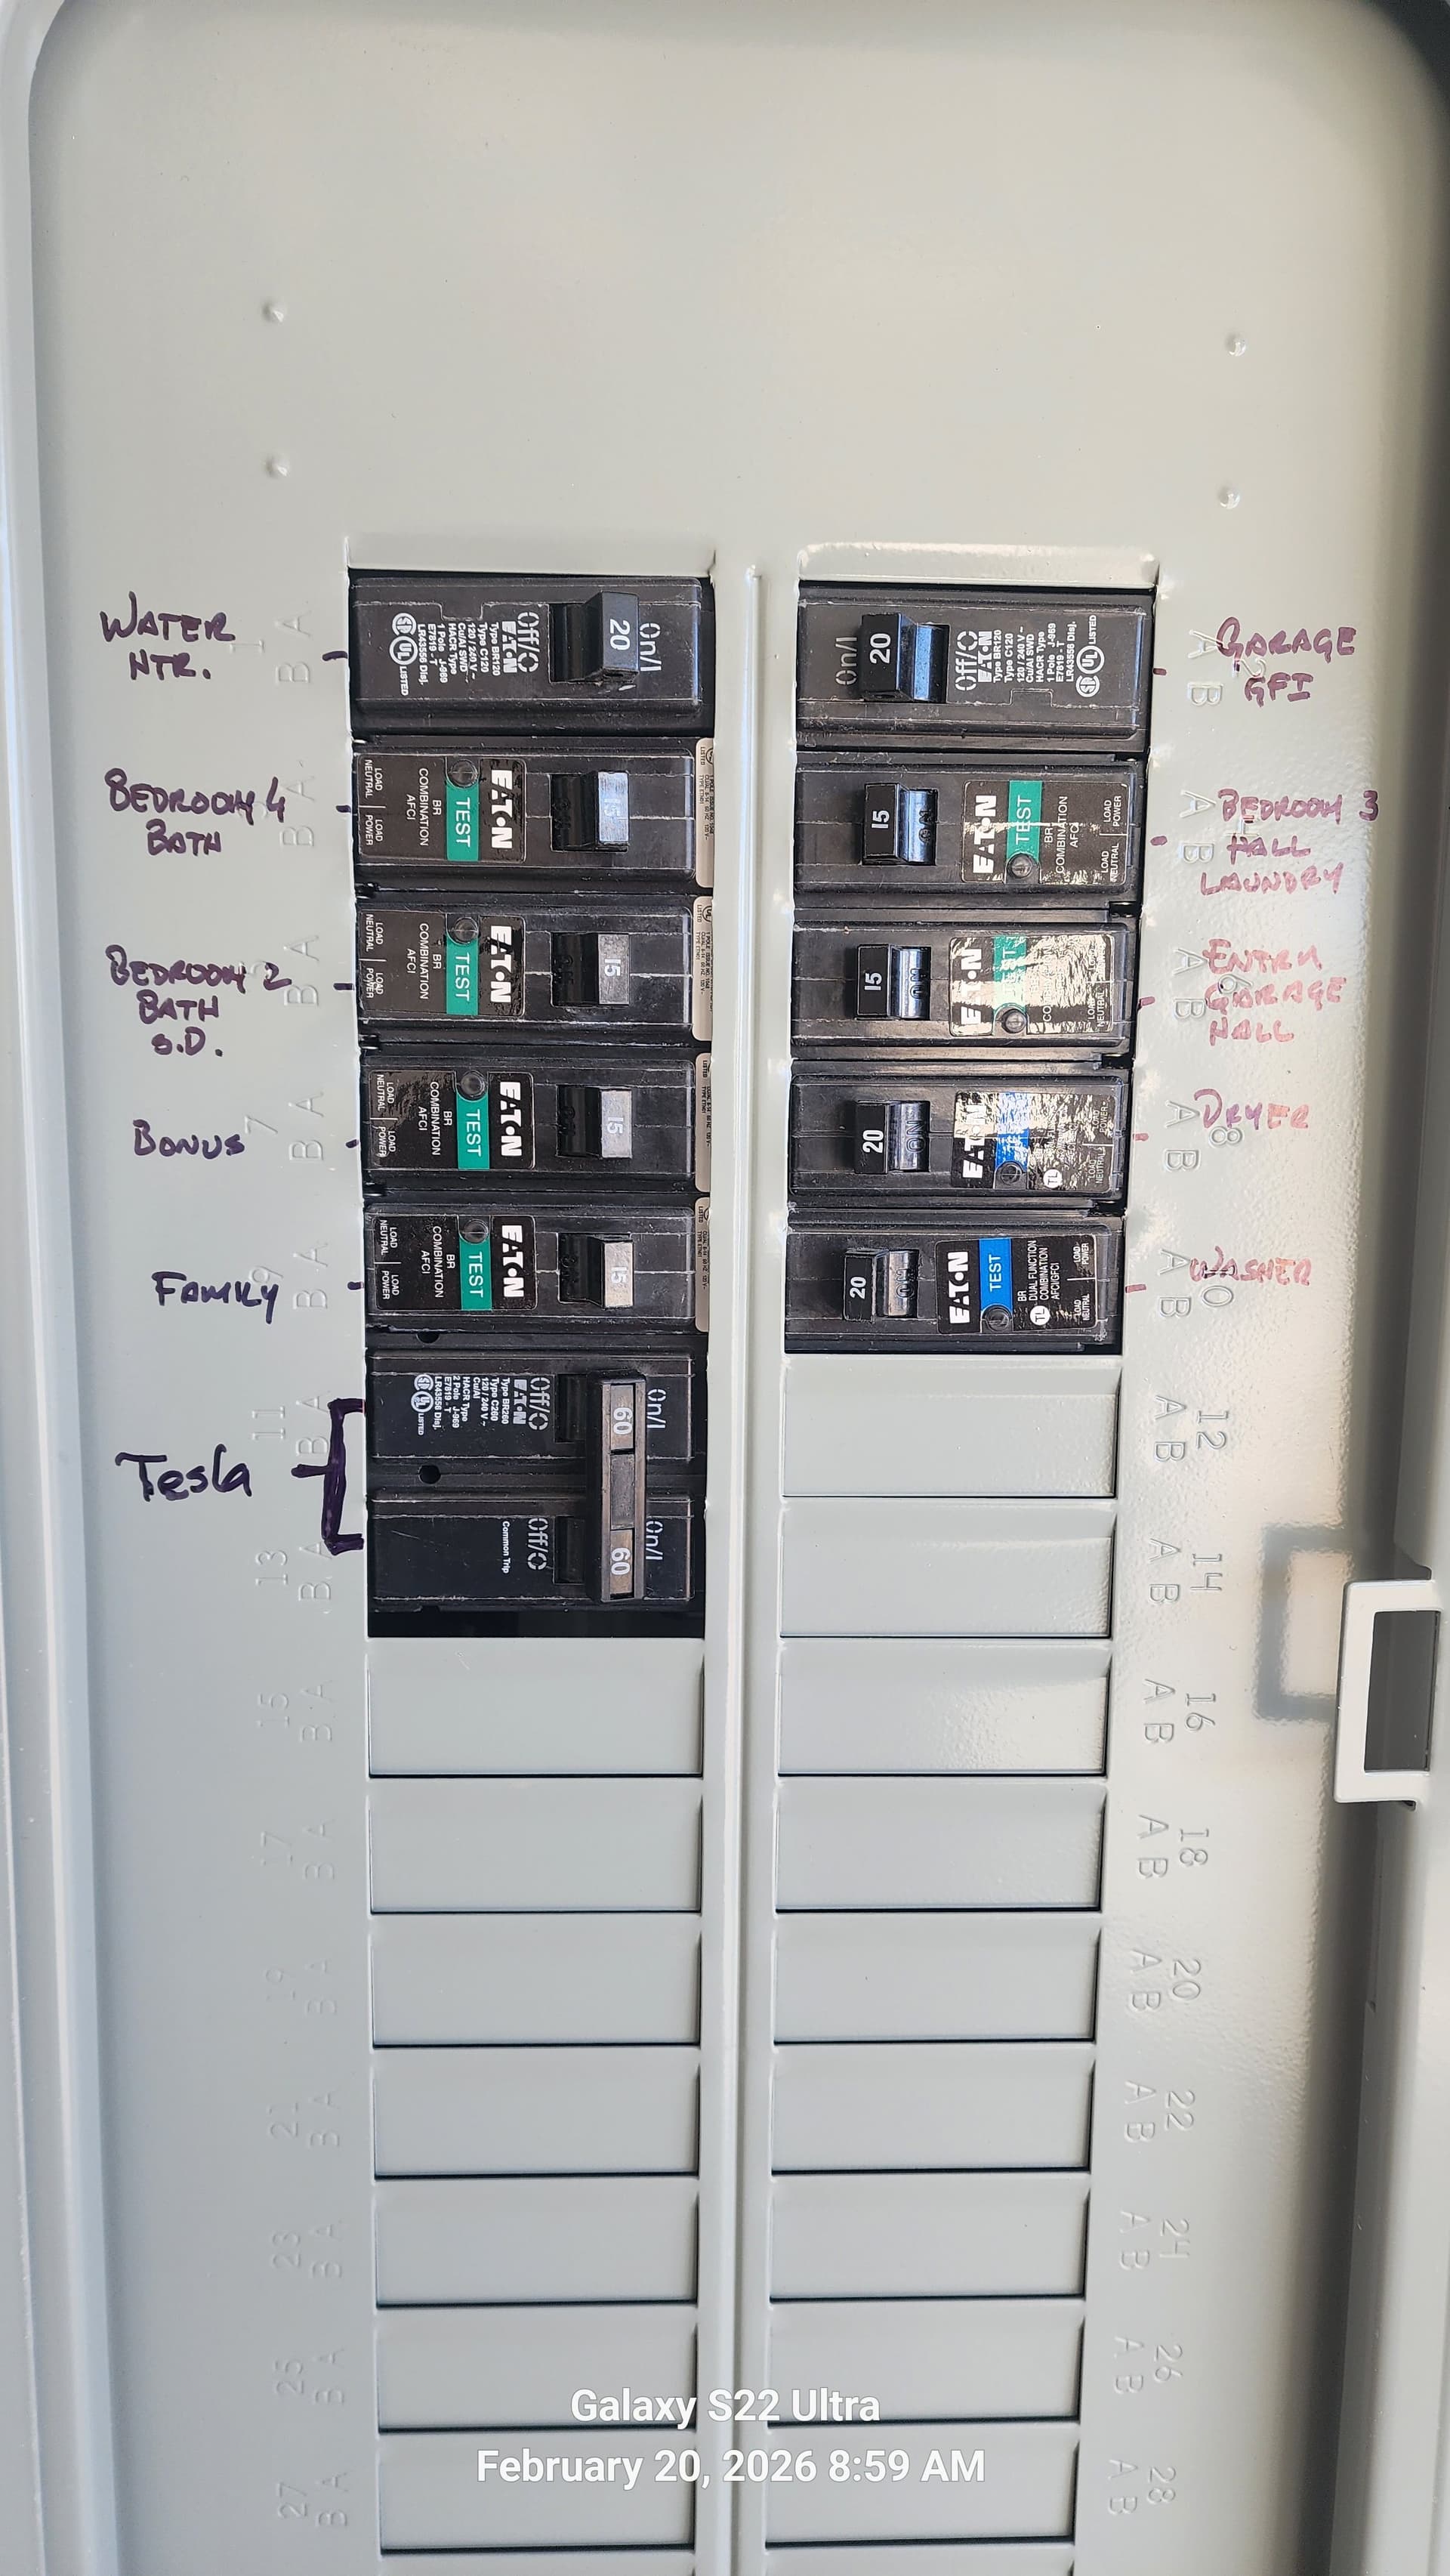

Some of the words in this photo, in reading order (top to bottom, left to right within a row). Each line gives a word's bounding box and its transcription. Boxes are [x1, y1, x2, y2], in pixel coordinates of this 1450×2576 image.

[100, 591, 236, 642] WATER
[1088, 614, 1097, 644] LISTED
[477, 622, 488, 647] Type
[491, 622, 499, 644] Type
[501, 621, 517, 673] EATON
[609, 618, 631, 651] 20
[869, 632, 891, 664] 20
[993, 629, 1002, 659] BR120
[1004, 633, 1013, 657] C120
[1026, 634, 1035, 656] SWD
[1036, 631, 1046, 654] Type
[1187, 629, 1223, 659] A
[1216, 616, 1357, 664] GARAGE
[480, 648, 489, 673] C120
[492, 647, 501, 676] BR120
[977, 631, 992, 683] EATON
[1017, 645, 1026, 660] 240
[1047, 654, 1056, 675] Pole
[400, 666, 409, 696] LISTED
[993, 660, 1003, 683] Type
[1004, 659, 1014, 683] Type
[1017, 668, 1026, 683] 120
[1035, 655, 1044, 683] HACR
[1186, 681, 1223, 706] B
[1244, 672, 1314, 708] GFI
[365, 759, 373, 798] NEUTRAL
[375, 768, 383, 791] LOAD
[104, 768, 255, 826] BEDROOM
[266, 777, 285, 823] 4
[406, 793, 416, 820] AFCI
[419, 768, 429, 847] COMBINATION
[432, 799, 442, 815] BR
[492, 769, 513, 849] EATON
[1103, 799, 1112, 823] LOAD
[1112, 795, 1121, 827] POWER
[1217, 787, 1343, 825] BEDROOM
[1359, 789, 1379, 822] 3
[366, 814, 374, 846] POWER
[375, 819, 383, 842] LOAD
[455, 797, 470, 848] TEST
[872, 810, 890, 829] 15
[973, 795, 997, 873] EATON
[1015, 795, 1032, 845] TEST
[1044, 826, 1054, 843] BR
[1056, 795, 1068, 874] COMBINATION
[1100, 850, 1109, 873] LOAD
[1110, 843, 1119, 882] NEUTRAL
[1226, 835, 1312, 865] HALL
[1200, 861, 1344, 895] LAUNDRY
[105, 944, 246, 994] BEDROOM
[263, 961, 292, 990] 2
[406, 948, 416, 974] AFCI
[419, 922, 430, 999] COMBINATION
[432, 954, 442, 969] BR
[491, 925, 512, 1003] EATON
[603, 958, 622, 977] 15
[455, 952, 470, 1002] TEST
[864, 972, 883, 991] 15
[961, 949, 982, 1025] ETON
[136, 989, 219, 1024] BATH
[1205, 977, 1347, 1015] GARAGE
[377, 1074, 385, 1111] NEUTRAL
[386, 1082, 394, 1104] LOAD
[418, 1106, 427, 1131] AFCI
[430, 1081, 441, 1156] COMBINATION
[443, 1110, 452, 1126] BR
[500, 1081, 523, 1157] EATON
[1193, 1088, 1310, 1130] DRYER
[132, 1119, 245, 1160] BONUS
[466, 1109, 481, 1157] TEST
[606, 1117, 624, 1134] 15
[906, 1120, 926, 1153] ON
[962, 1104, 987, 1178] EATON
[1209, 1126, 1244, 1147] 8
[378, 1126, 387, 1157] POWER
[387, 1131, 396, 1153] LOAD
[862, 1129, 884, 1154] 20
[421, 1249, 430, 1274] AFCI
[433, 1225, 444, 1299] COMBINATION
[446, 1254, 455, 1269] BR
[501, 1225, 525, 1298] EATON
[1027, 1240, 1037, 1281] FUNCTION
[1081, 1242, 1090, 1265] POWER
[1189, 1246, 1312, 1286] WASHER
[468, 1251, 484, 1299] TEST
[850, 1276, 867, 1299] 20
[948, 1251, 970, 1324] EATON
[988, 1253, 1002, 1293] TEST
[1038, 1247, 1050, 1301] COMBINATION
[1050, 1262, 1060, 1300] AFCI/GFCI
[1017, 1290, 1027, 1302] BR
[1028, 1282, 1038, 1301] DUAL
[1081, 1293, 1090, 1321] NEUTRAL
[1073, 1299, 1081, 1318] LOAD
[491, 1377, 499, 1398] Type
[501, 1377, 511, 1397] Type
[512, 1379, 528, 1425] EATON
[490, 1400, 499, 1422] C260
[501, 1398, 510, 1425] BR260
[613, 1407, 633, 1435] 60
[1154, 1395, 1187, 1420] A
[251, 1406, 285, 1441] 11
[1195, 1410, 1229, 1450] 12
[1154, 1441, 1186, 1463] B
[115, 1444, 252, 1502] Tesla
[501, 1521, 511, 1555] Common
[1149, 1537, 1181, 1563] A
[255, 1549, 288, 1586] 13
[501, 1557, 511, 1574] Trip
[611, 1547, 631, 1576] 60
[1190, 1553, 1223, 1591] 14
[1149, 1583, 1180, 1604] B
[1185, 1692, 1216, 1732] 16
[1179, 1828, 1210, 1867] 18
[1171, 1959, 1202, 2000] 20
[1164, 2089, 1196, 2132] 22
[1159, 2218, 1191, 2259] 24
[1153, 2343, 1183, 2383] 26
[1146, 2466, 1177, 2505] 28
